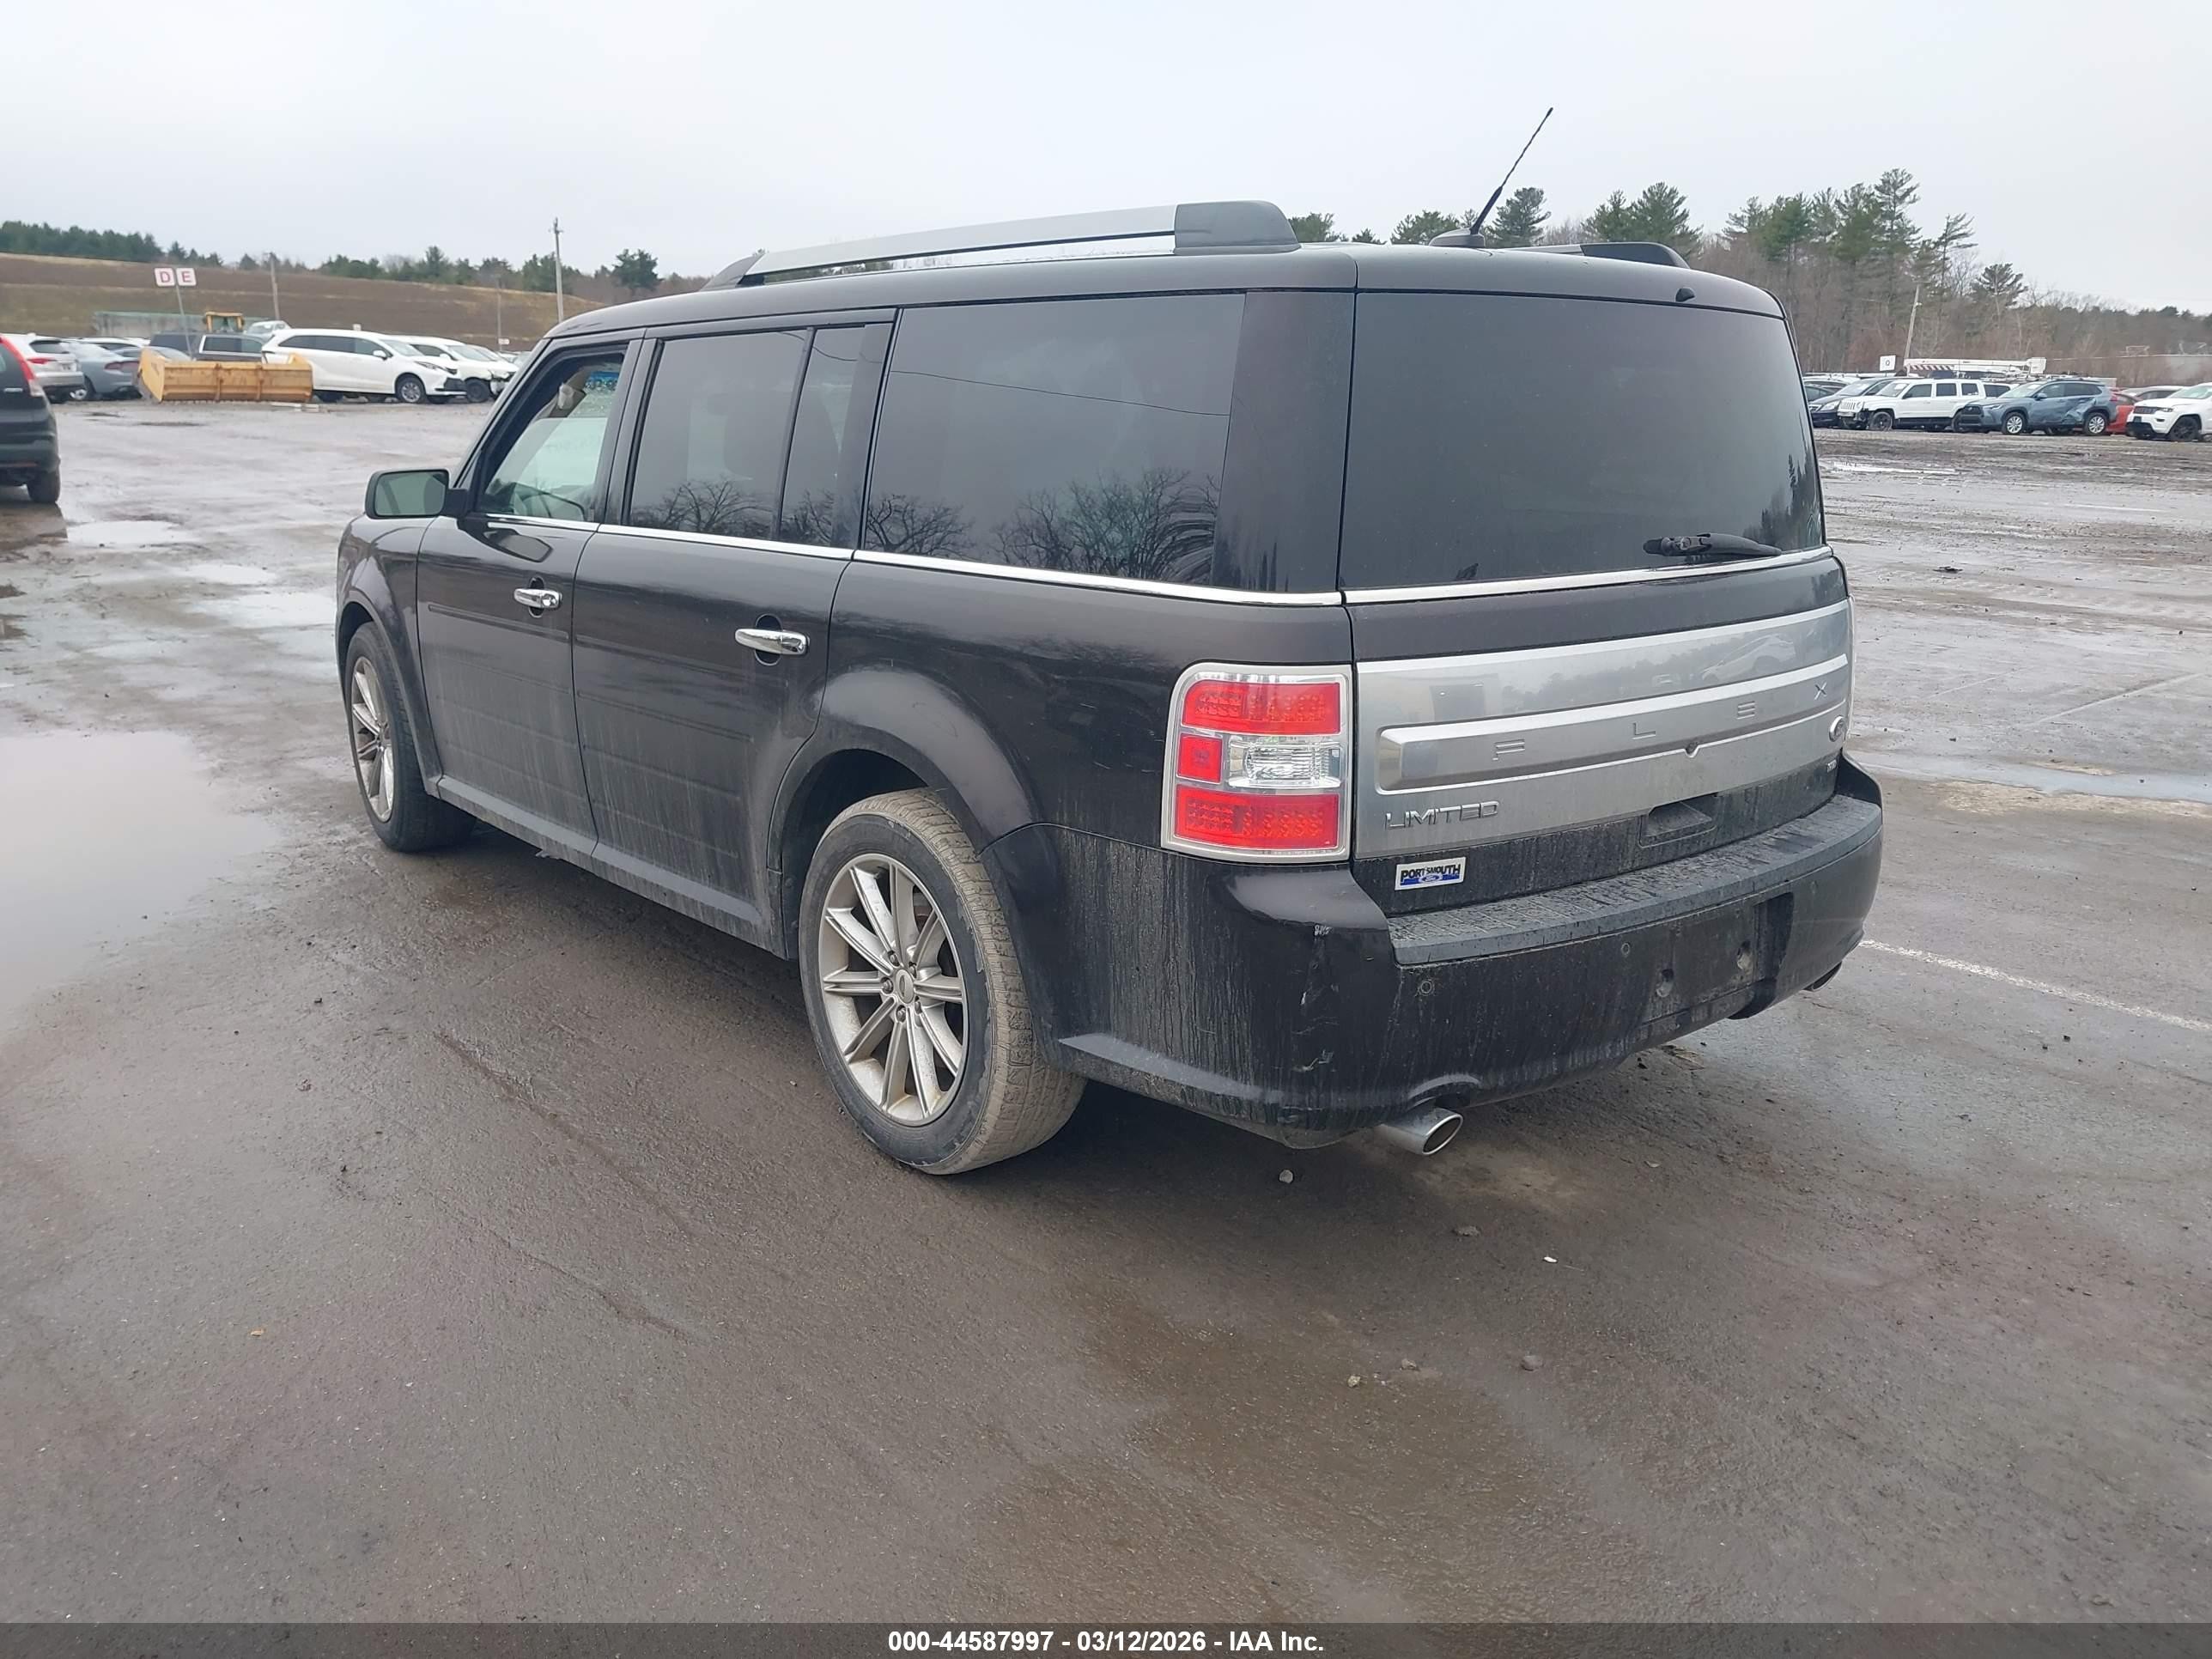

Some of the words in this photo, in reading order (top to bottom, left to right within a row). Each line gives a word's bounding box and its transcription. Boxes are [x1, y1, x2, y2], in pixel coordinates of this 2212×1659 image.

[160, 270, 171, 283] D
[181, 270, 192, 283] E
[1385, 801, 1499, 829] LIMITED
